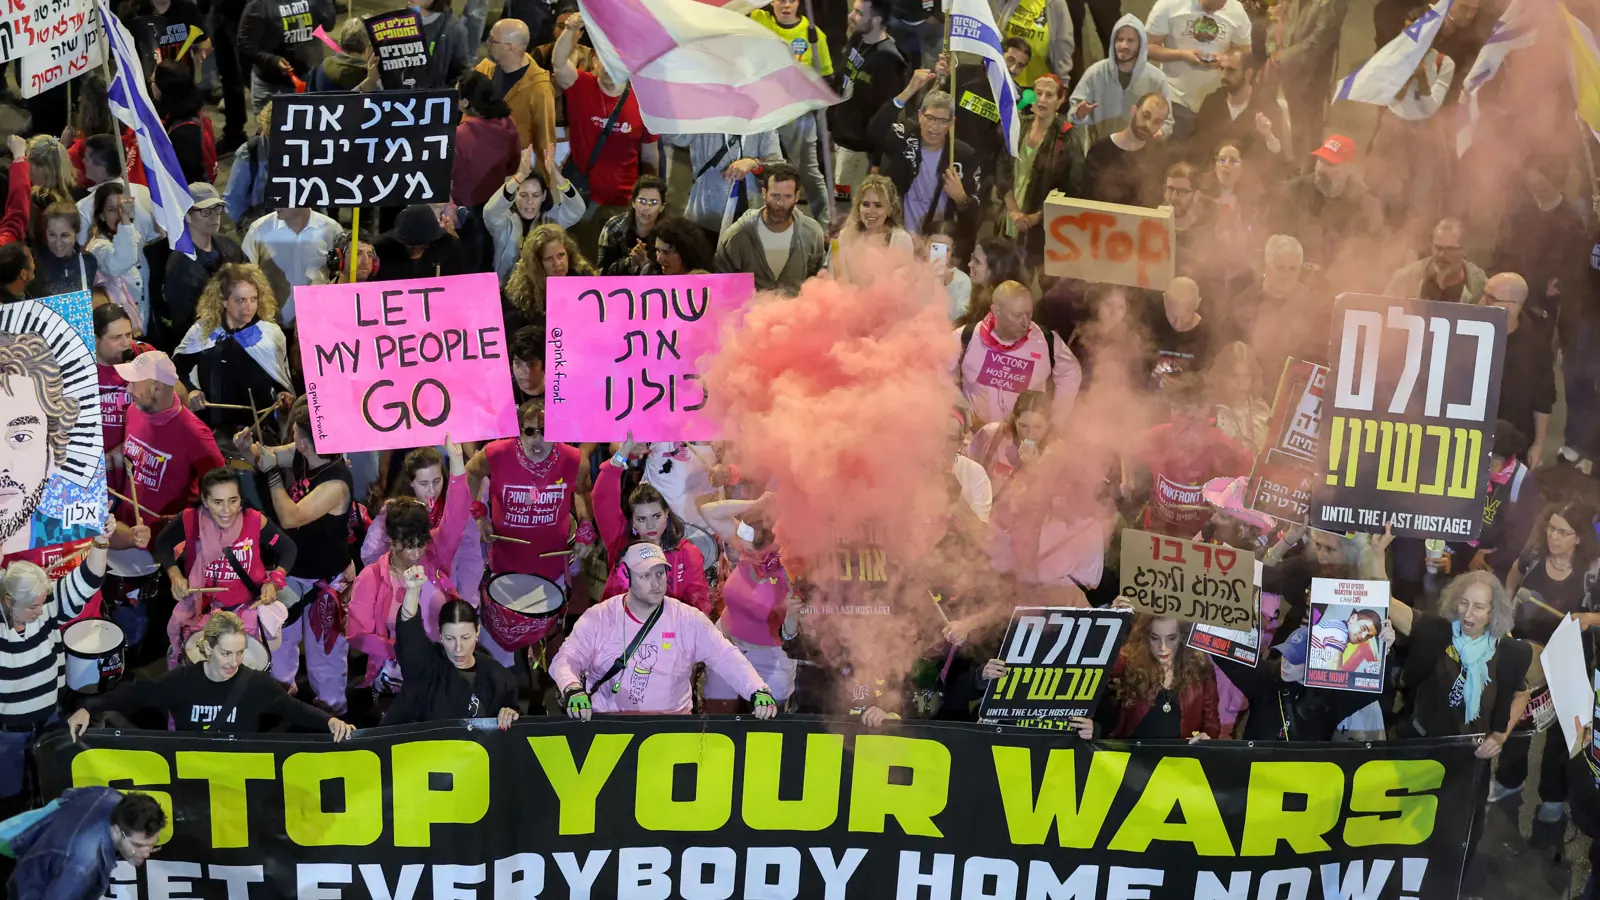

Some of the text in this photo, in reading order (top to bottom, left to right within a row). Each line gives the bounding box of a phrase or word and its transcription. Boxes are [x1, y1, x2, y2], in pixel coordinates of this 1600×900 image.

[50, 36, 79, 60] שזה
[382, 54, 427, 71] למלחמה
[32, 50, 88, 94] לא הסוף
[280, 97, 451, 132] תציל את
[282, 134, 449, 168] המדינה
[272, 171, 434, 208] מעצמך
[355, 287, 445, 327] LET
[578, 287, 710, 323] שחרר
[315, 326, 501, 377] MY PEOPLE
[615, 329, 681, 363] את
[991, 353, 1029, 370] VICTORY
[548, 327, 568, 405] @pink.front
[986, 367, 1026, 382] HOSTAGE
[1334, 306, 1496, 421] כולם
[605, 367, 709, 421] כולנו
[990, 378, 1015, 390] DEAL
[308, 382, 328, 440] @pink.front
[361, 378, 451, 433] GO
[1326, 416, 1483, 499] עכשיו!
[1160, 480, 1202, 504] PINKFRONT
[65, 502, 97, 527] אלון
[1321, 505, 1472, 535] UNTIL THE LAST HOSTAGE!
[855, 605, 891, 615] HOSTAGE!
[1005, 613, 1123, 665] כולם
[1192, 632, 1232, 651] HOME NOW!
[992, 667, 1104, 700] עכשיו!
[1308, 669, 1328, 681] HOME
[1328, 671, 1349, 684] NOW!
[986, 708, 1088, 717] UNTIL THE LAST HOSTAGE!
[72, 732, 1446, 857] STOP YOUR WARS
[297, 846, 869, 900] EVERYBODY
[896, 851, 1165, 900] HOME
[1194, 858, 1429, 900] NOW!
